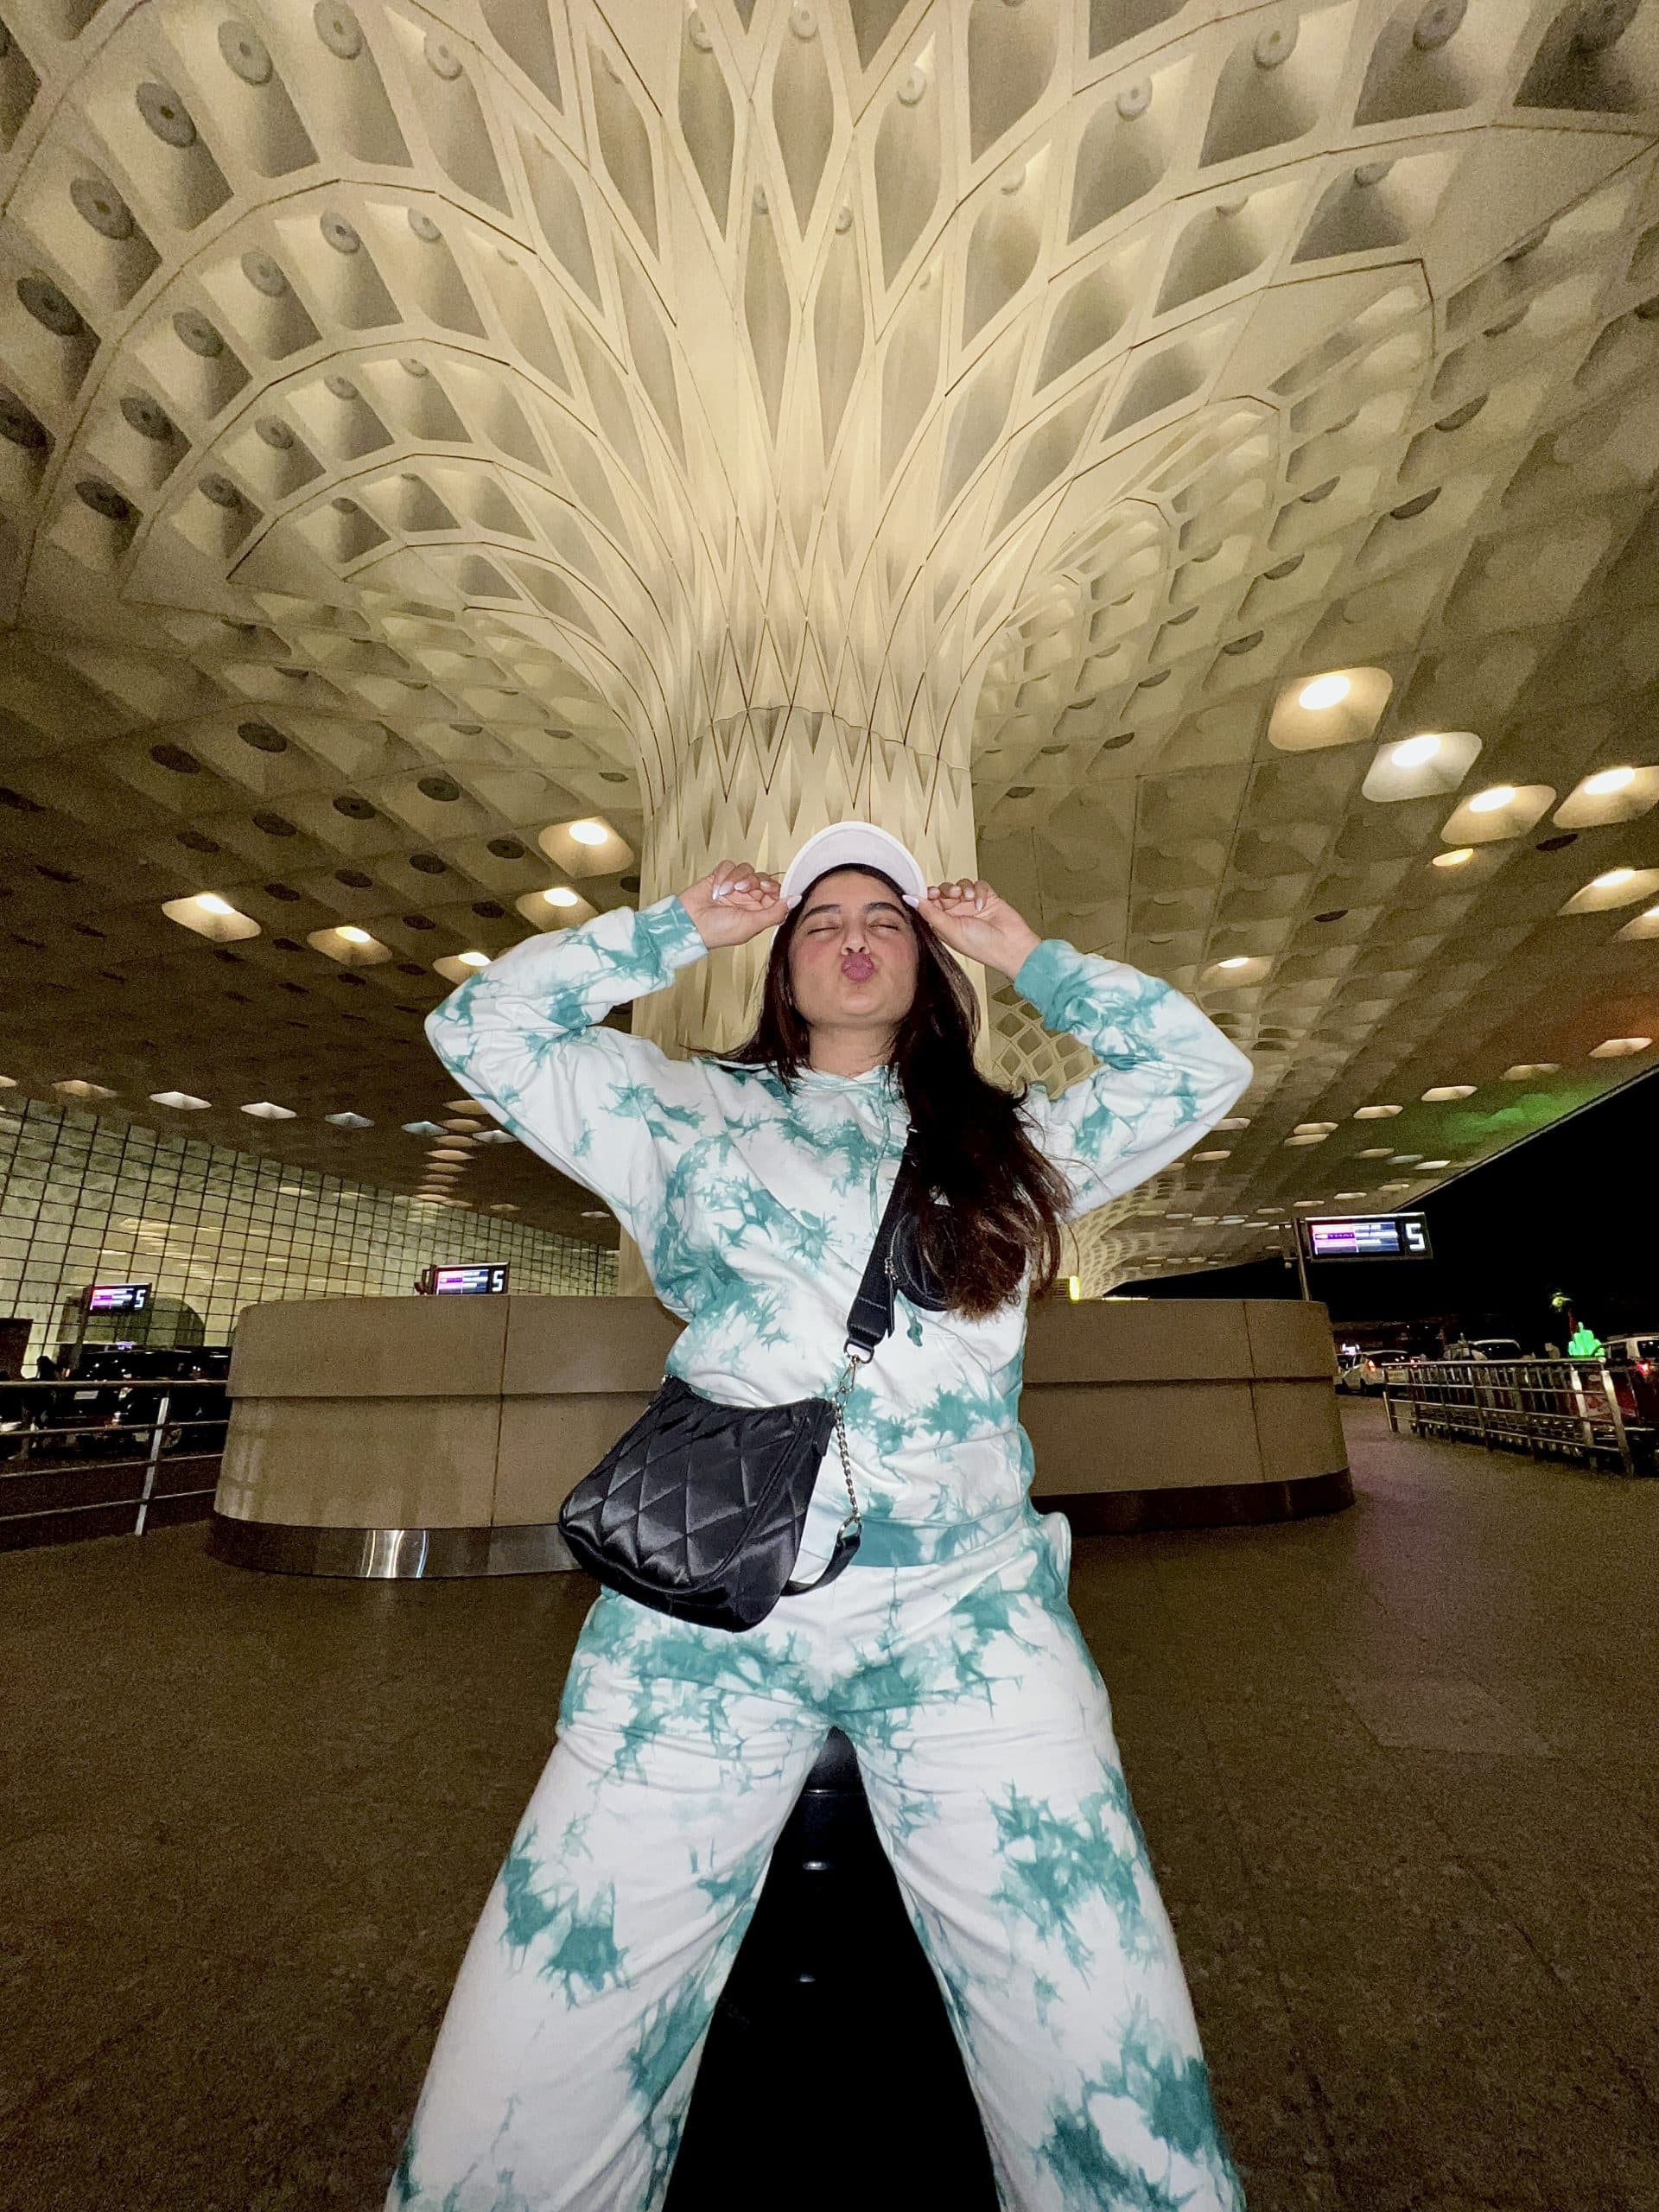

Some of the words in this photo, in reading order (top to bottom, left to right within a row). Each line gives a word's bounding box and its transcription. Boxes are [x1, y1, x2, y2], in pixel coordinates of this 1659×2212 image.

[1406, 1223, 1425, 1250] 5
[493, 1270, 504, 1292] 5
[134, 1289, 146, 1307] 5
